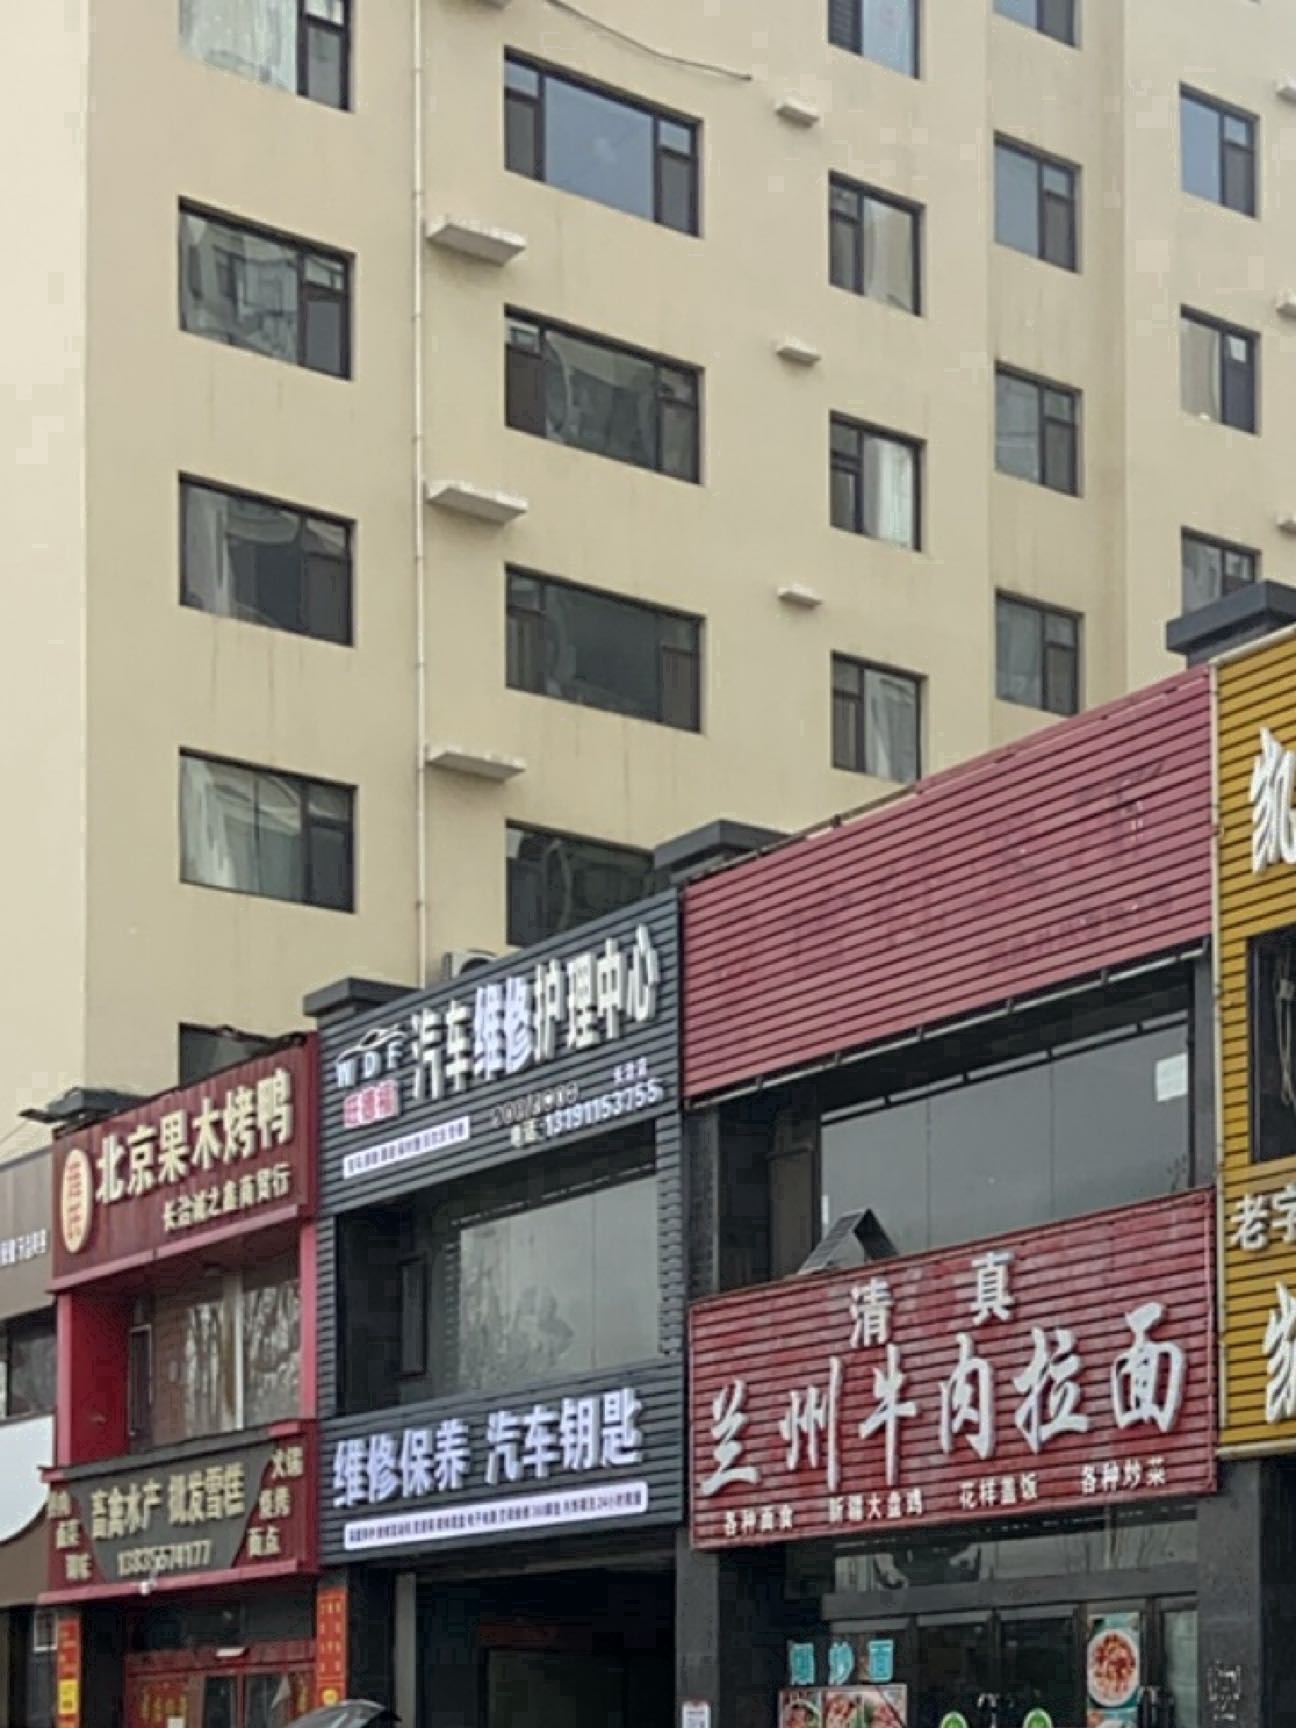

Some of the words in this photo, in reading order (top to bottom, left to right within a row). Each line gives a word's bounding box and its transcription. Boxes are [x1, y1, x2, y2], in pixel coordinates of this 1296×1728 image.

[96, 1067, 293, 1204] 北京果木烤鸭
[849, 1250, 1017, 1349] 清真
[333, 1418, 470, 1508] 维修保养
[486, 1388, 643, 1484] 汽车钥匙
[701, 1302, 1187, 1497] 兰州牛肉拉面
[1080, 1456, 1167, 1496] 各种炒菜
